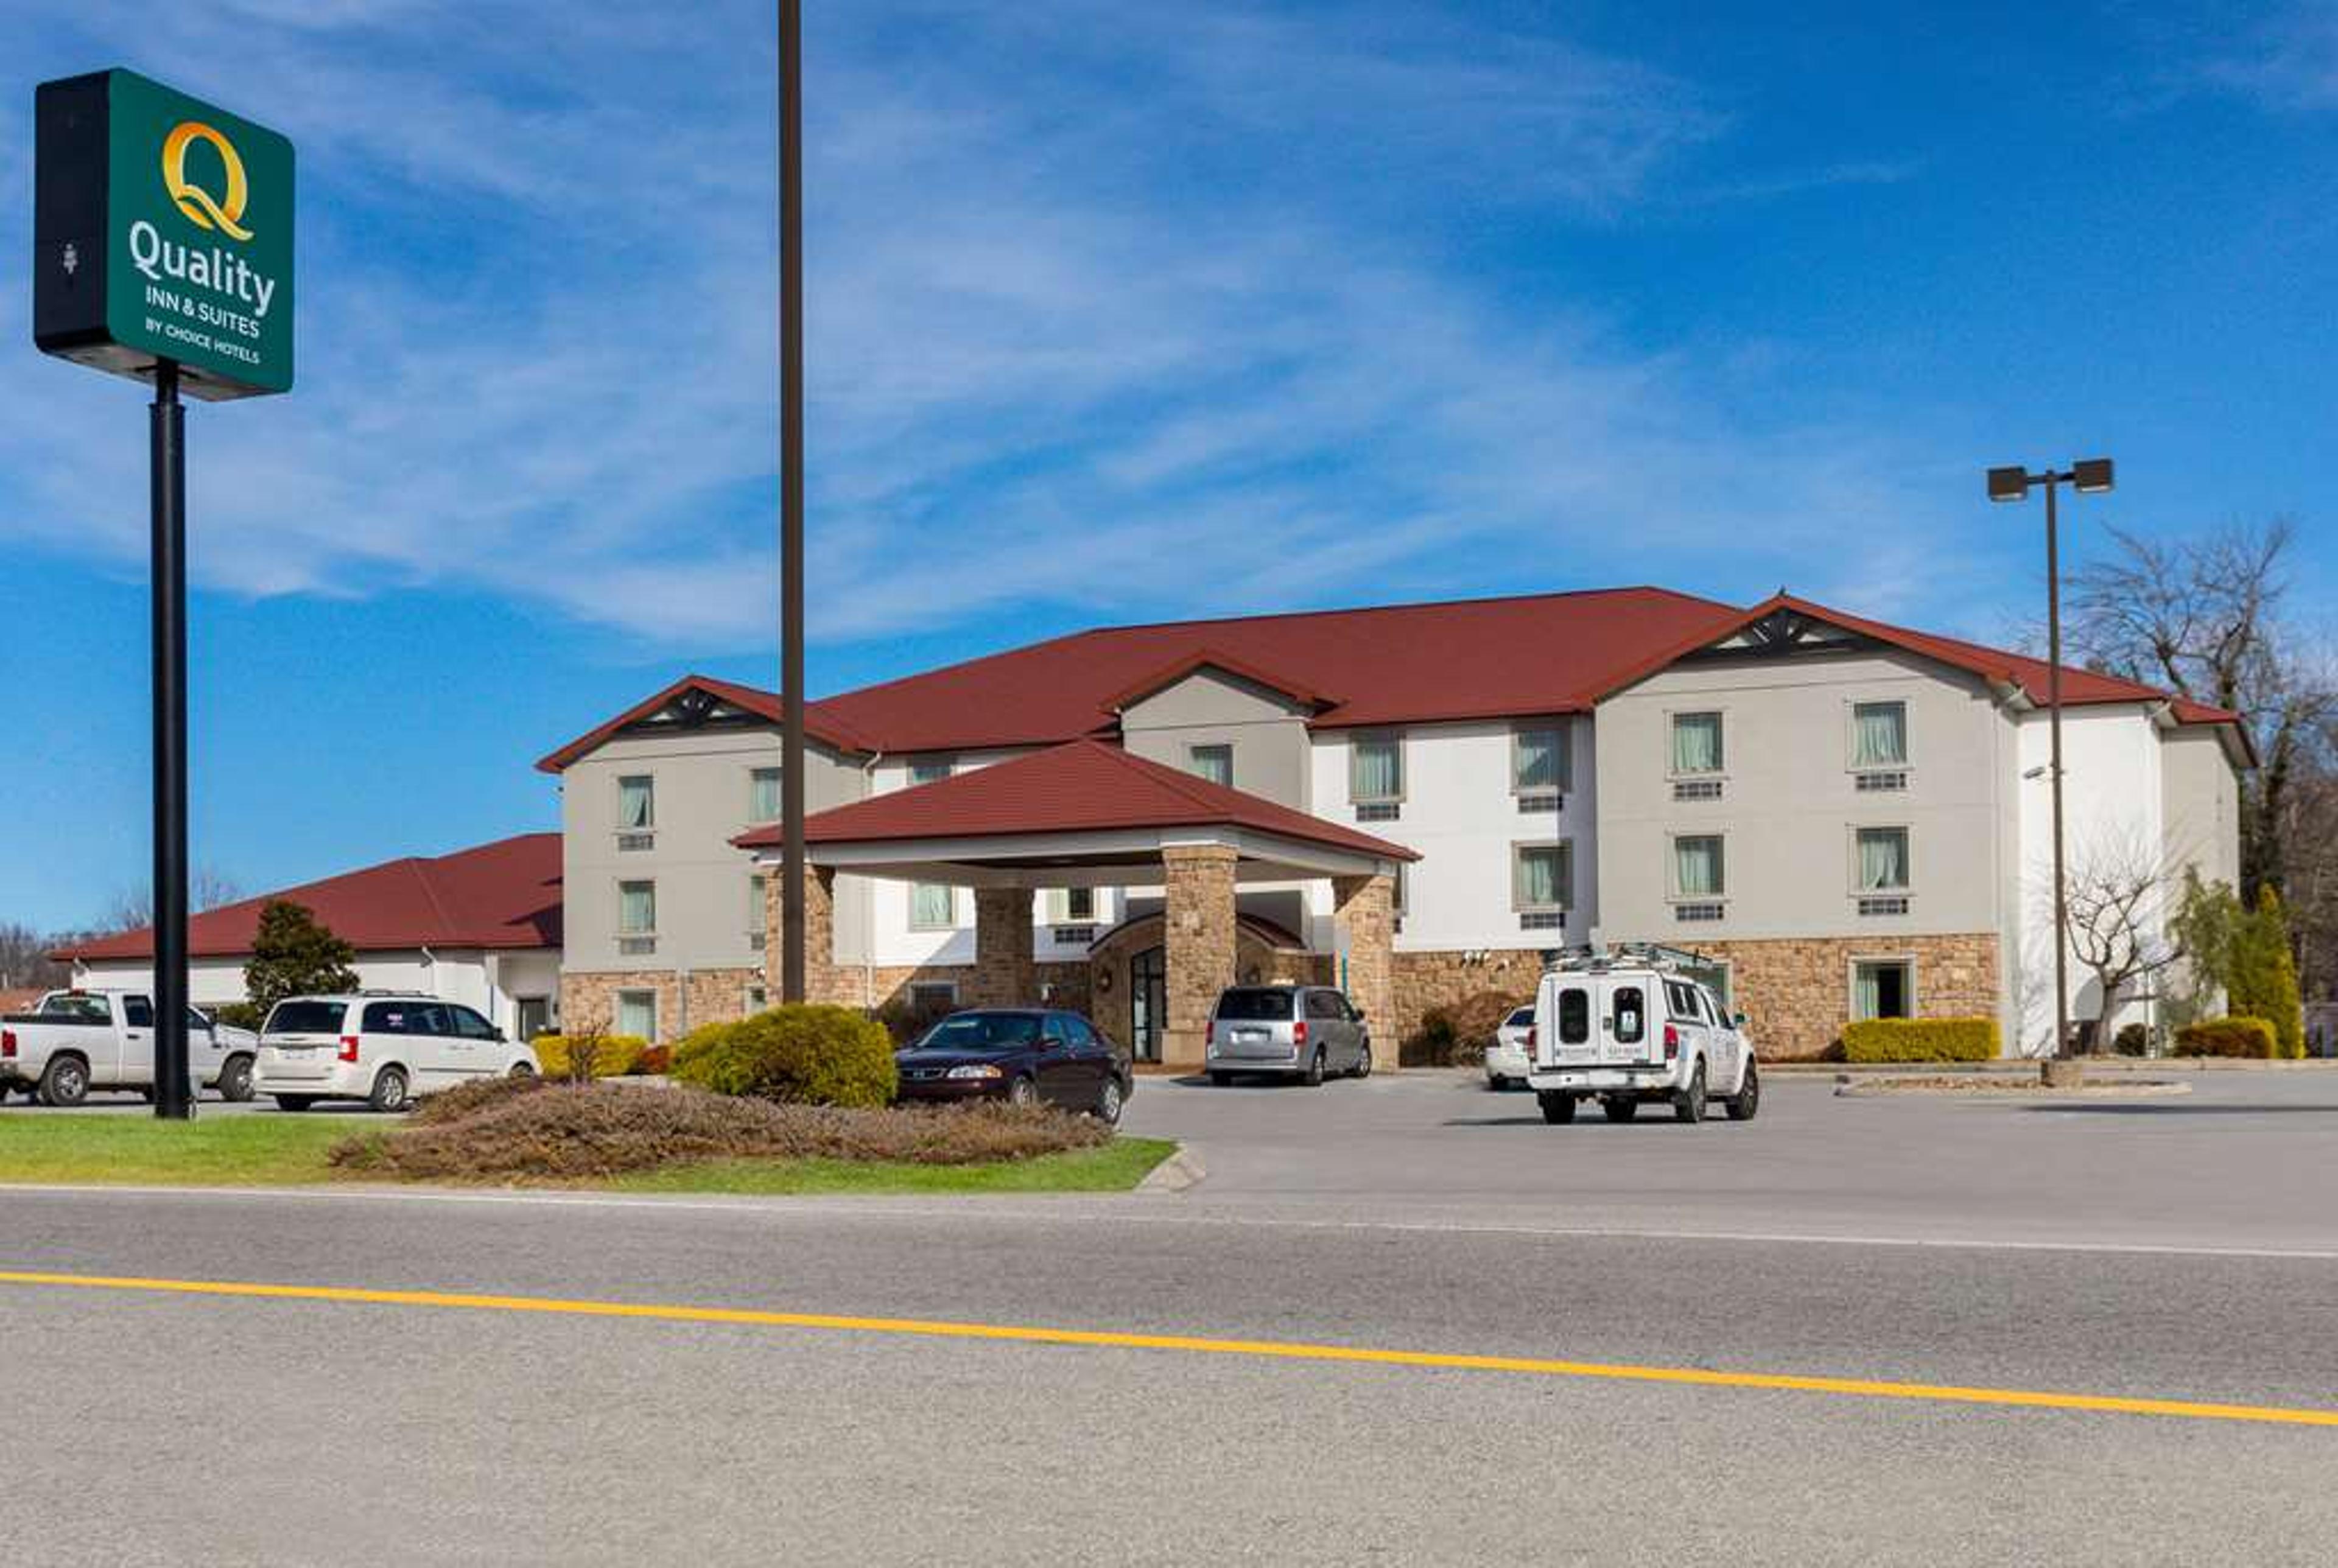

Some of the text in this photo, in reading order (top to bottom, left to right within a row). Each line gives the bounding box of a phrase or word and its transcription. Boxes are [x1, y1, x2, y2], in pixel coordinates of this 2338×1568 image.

[163, 121, 254, 240] Q
[129, 220, 275, 317] Quality
[146, 284, 260, 338] INN & SUITES
[146, 317, 261, 364] BY CHOICE HOTELS
